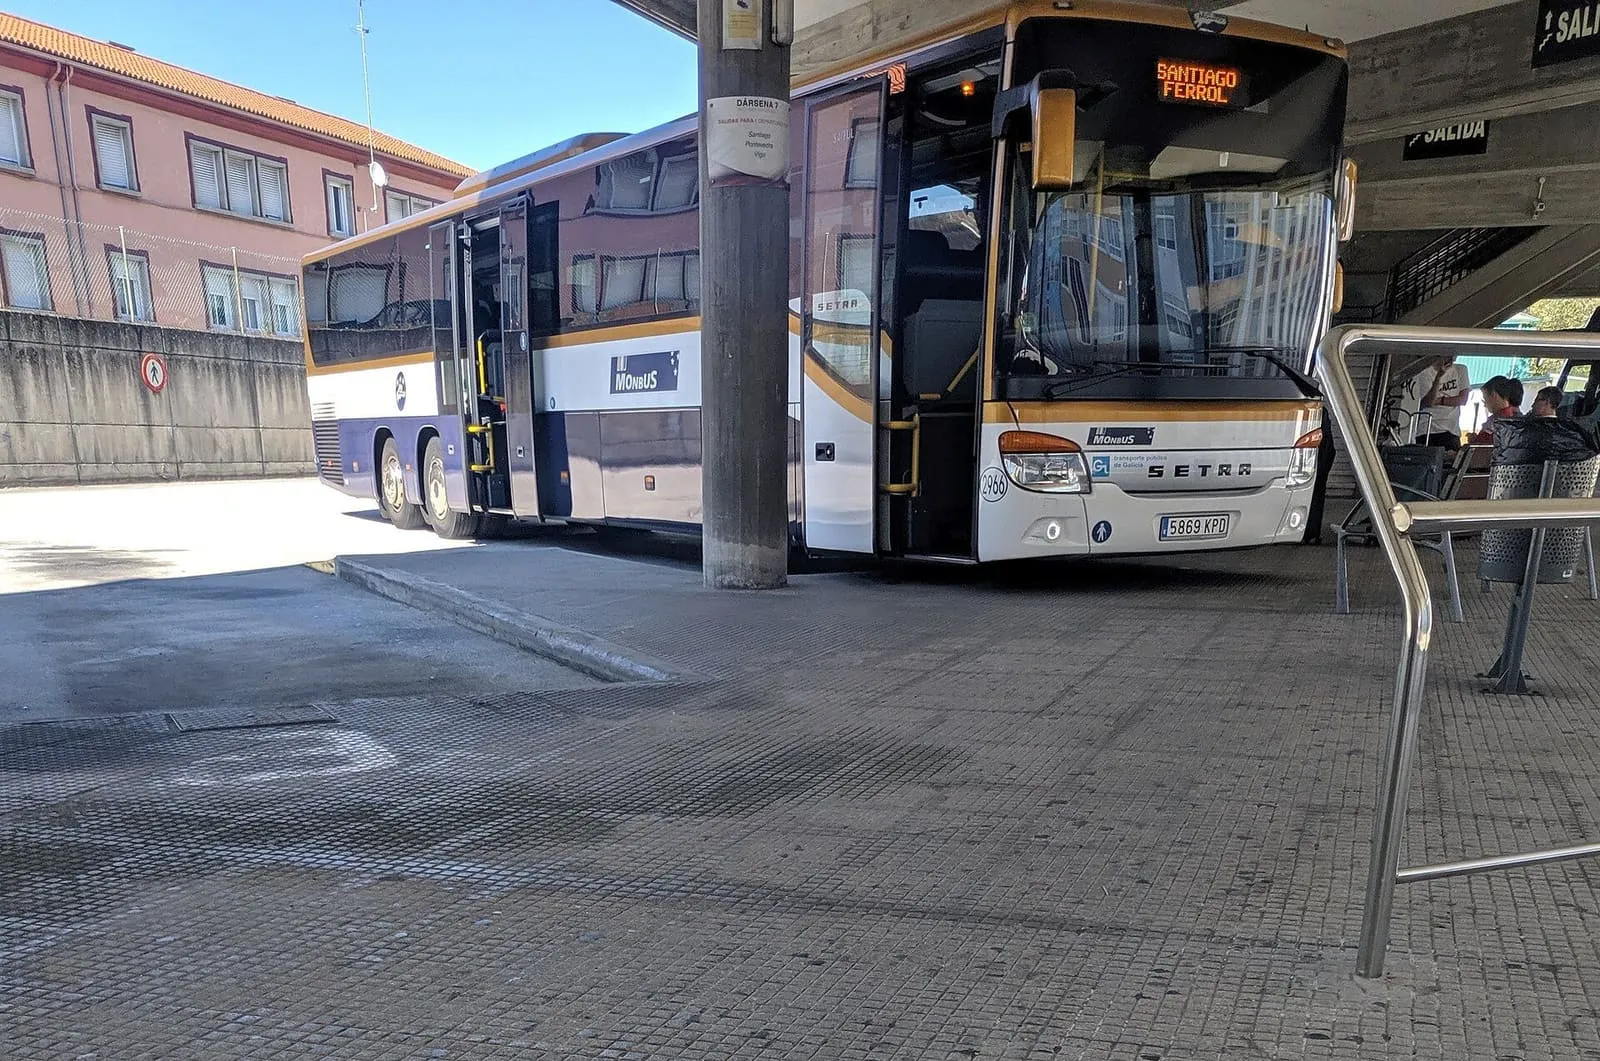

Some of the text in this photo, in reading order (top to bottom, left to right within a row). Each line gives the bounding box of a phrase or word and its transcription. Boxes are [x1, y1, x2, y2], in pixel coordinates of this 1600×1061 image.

[1157, 63, 1237, 88] SANTIAGO
[1163, 81, 1228, 103] FERROL
[736, 98, 774, 109] DÁRSENA
[748, 131, 771, 140] Santiago
[753, 151, 767, 159] Vigo
[817, 299, 858, 312] SETRA
[615, 370, 658, 391] MONBUS
[1093, 435, 1135, 445] MONBUS
[1147, 463, 1252, 478] SETRA
[982, 474, 1005, 495] 2966
[1170, 518, 1226, 535] 5869 KPD
